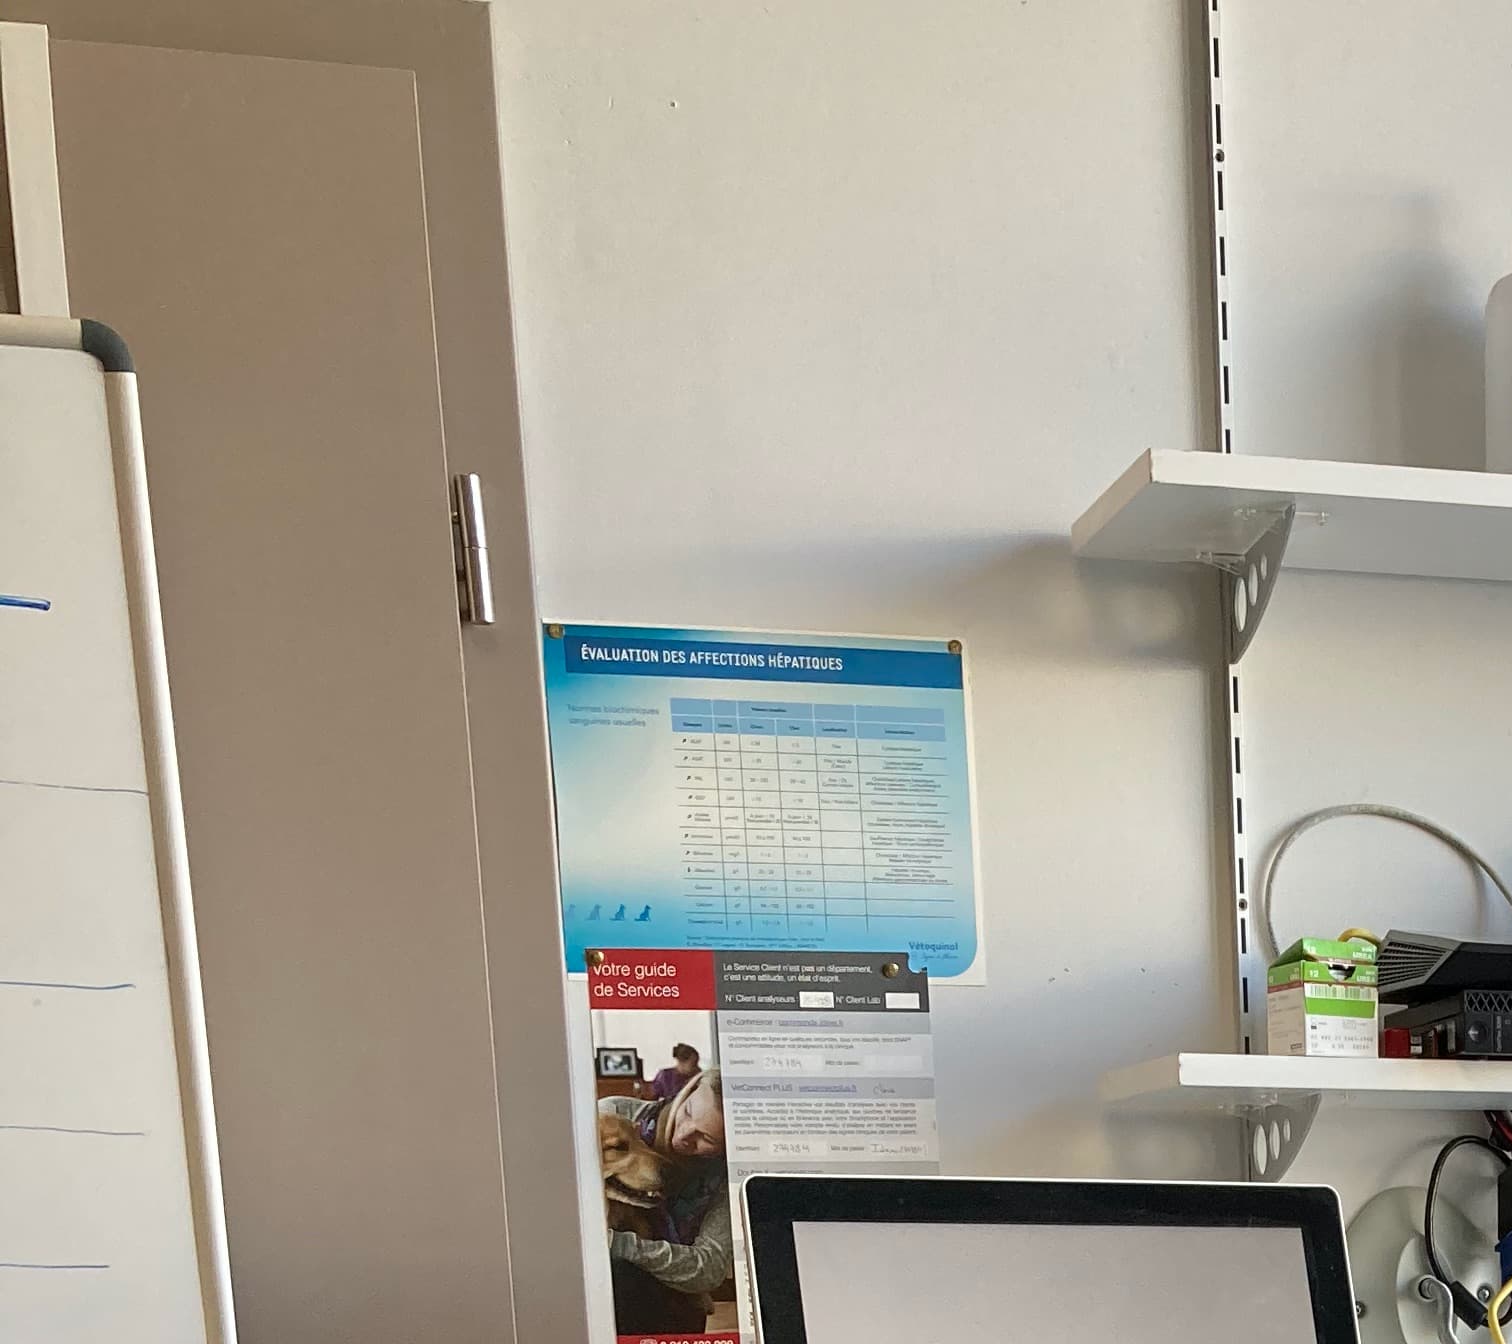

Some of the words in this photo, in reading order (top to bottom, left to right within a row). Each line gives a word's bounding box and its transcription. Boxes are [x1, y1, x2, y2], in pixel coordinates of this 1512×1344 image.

[580, 643, 660, 663] ÉVALUATION
[663, 651, 687, 664] DES
[689, 651, 765, 668] AFFECTIONS
[768, 652, 844, 671] HÉPATIQUES
[634, 962, 676, 980] guide
[734, 963, 760, 971] Service
[761, 964, 782, 972] Client
[1309, 970, 1319, 978] 12
[593, 982, 614, 997] de
[617, 982, 680, 998] Services
[772, 1084, 793, 1092] PLUS
